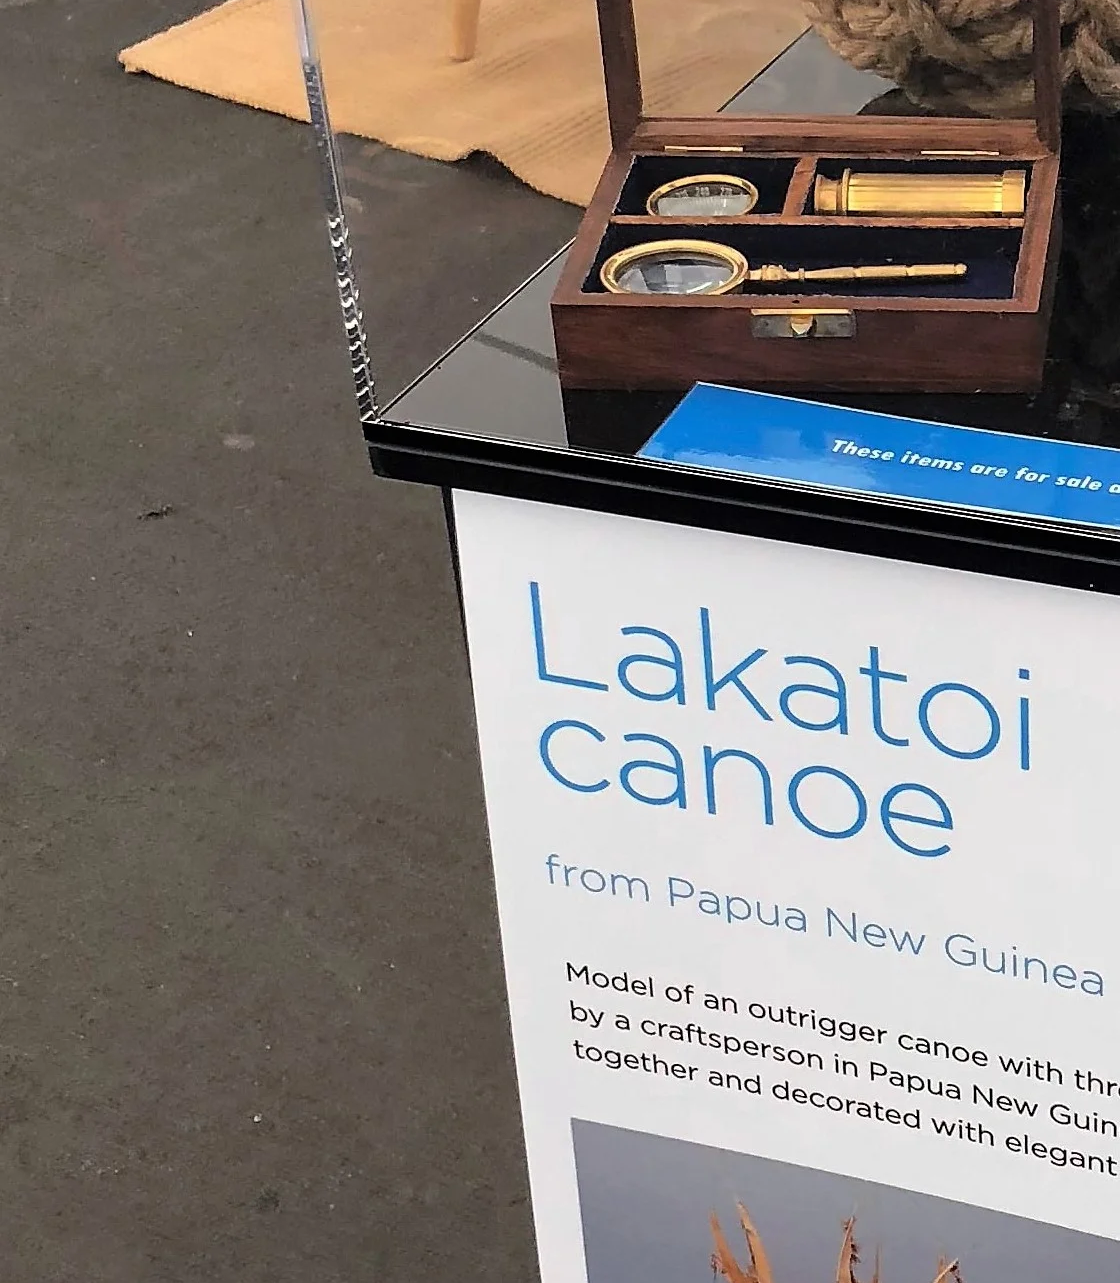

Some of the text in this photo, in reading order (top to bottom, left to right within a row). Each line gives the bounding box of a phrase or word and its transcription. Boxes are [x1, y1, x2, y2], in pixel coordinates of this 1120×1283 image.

[832, 439, 895, 461] These
[900, 450, 964, 472] items
[969, 464, 1009, 479] are
[1014, 467, 1050, 484] for
[1055, 474, 1101, 494] sale
[530, 581, 1031, 771] Lakatoi
[539, 719, 954, 858] canoe
[546, 854, 1105, 997] from Papua New Guinea
[566, 962, 654, 998] Model
[665, 984, 695, 1005] of
[703, 990, 739, 1014] an
[748, 1001, 888, 1045] outrigger
[898, 1032, 989, 1068] canoe
[1000, 1055, 1063, 1086] with
[569, 1000, 605, 1027] by
[615, 1011, 631, 1031] a
[640, 1019, 824, 1072] craftsperson
[833, 1052, 859, 1078] in
[869, 1061, 962, 1101] Papua
[973, 1085, 1039, 1119] New
[573, 1038, 699, 1083] together
[708, 1067, 762, 1096] and
[771, 1080, 921, 1131] decorated
[931, 1117, 996, 1148] with
[1005, 1134, 1118, 1178] elegant
